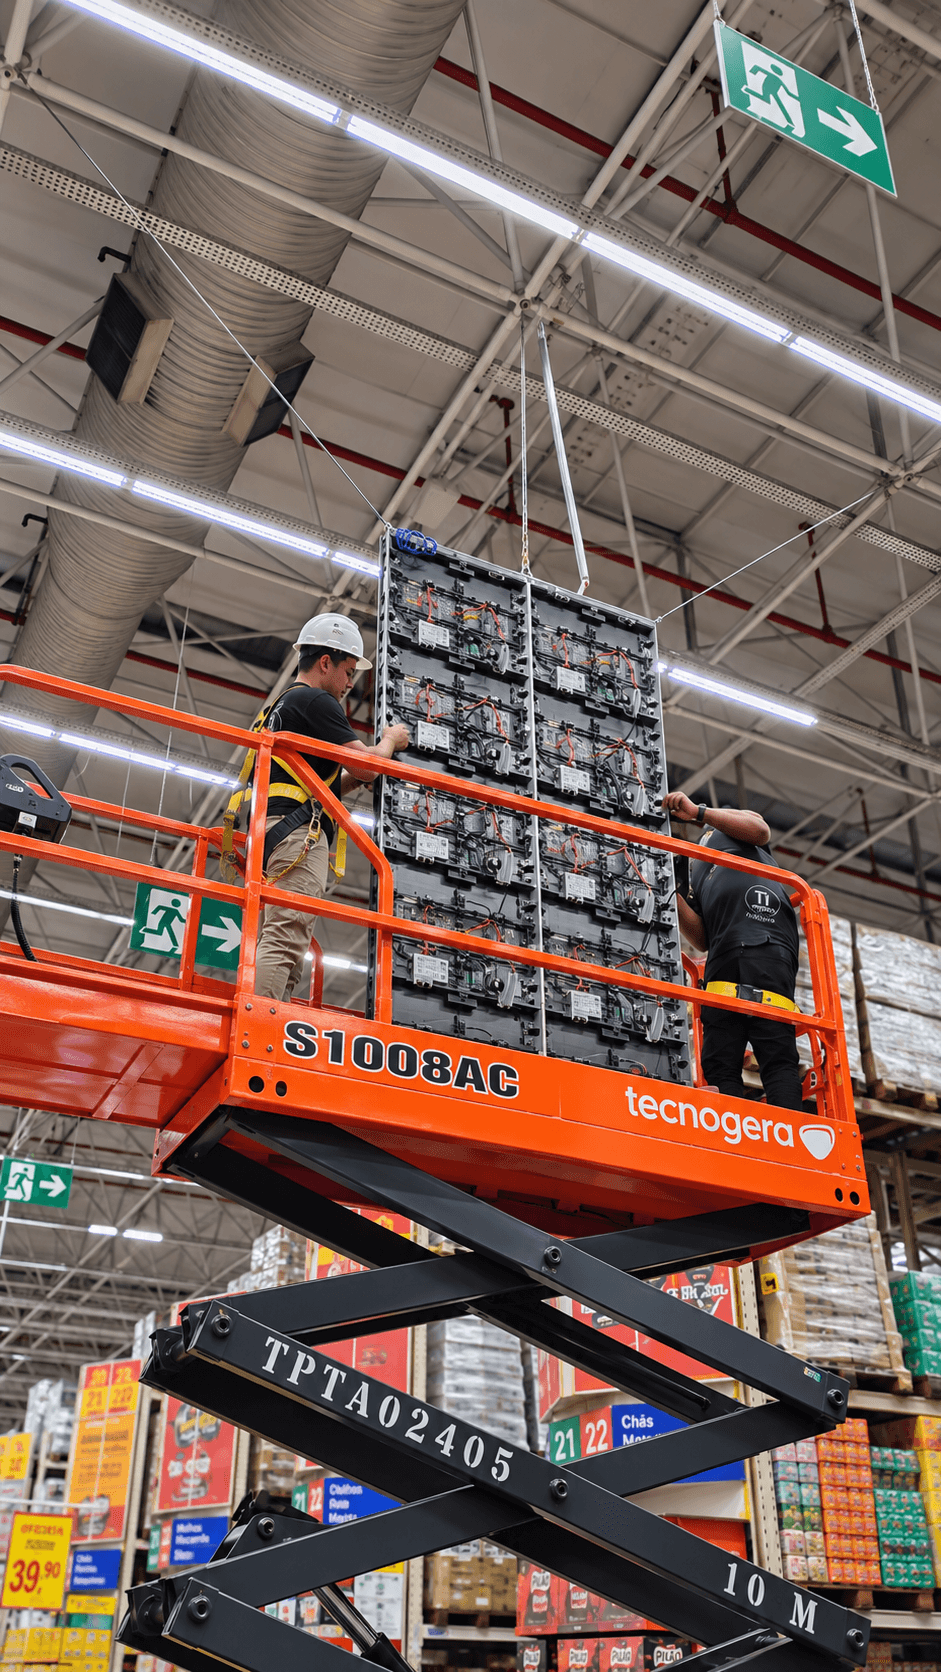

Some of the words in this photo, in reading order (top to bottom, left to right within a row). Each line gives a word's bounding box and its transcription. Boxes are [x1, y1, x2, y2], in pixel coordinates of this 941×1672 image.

[283, 1020, 520, 1099] S1008AC
[625, 1086, 794, 1147] tecnogera
[262, 1336, 514, 1481] TPTA02405
[554, 1428, 575, 1461] 21
[585, 1419, 609, 1454] 22
[723, 1563, 765, 1607] 10
[789, 1591, 818, 1634] M
